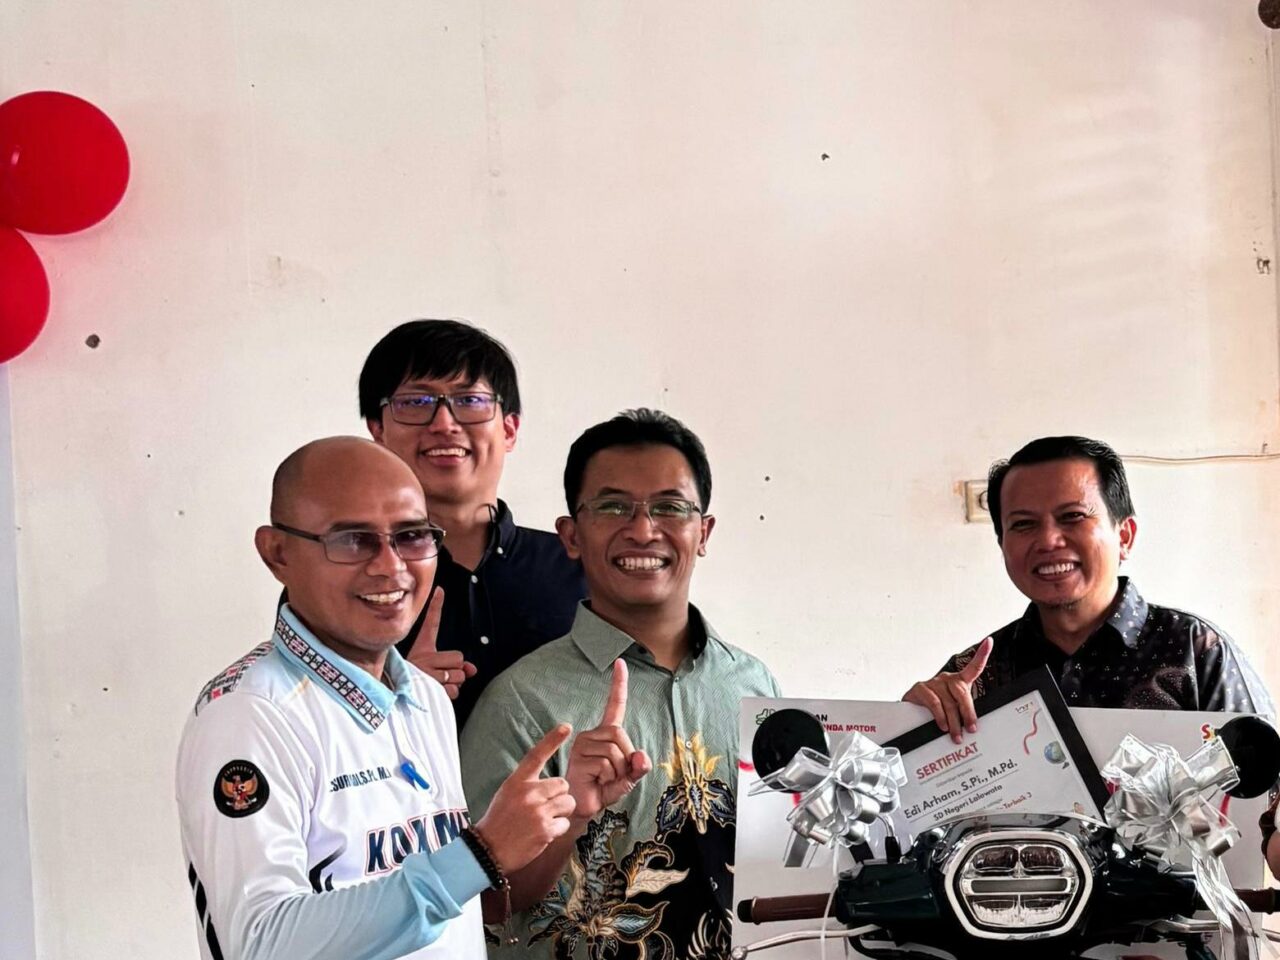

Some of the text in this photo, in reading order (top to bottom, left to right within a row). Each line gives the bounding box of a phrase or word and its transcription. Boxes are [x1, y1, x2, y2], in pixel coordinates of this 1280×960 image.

[823, 723, 876, 733] NDA MOTOR
[915, 742, 979, 780] SERTIFIKAT
[904, 804, 921, 819] Edi
[923, 789, 961, 811] Arham,
[961, 775, 989, 792] S.Pi.,
[988, 759, 1018, 779] M.Pd.
[933, 811, 944, 821] SD
[944, 799, 969, 818] Negeri
